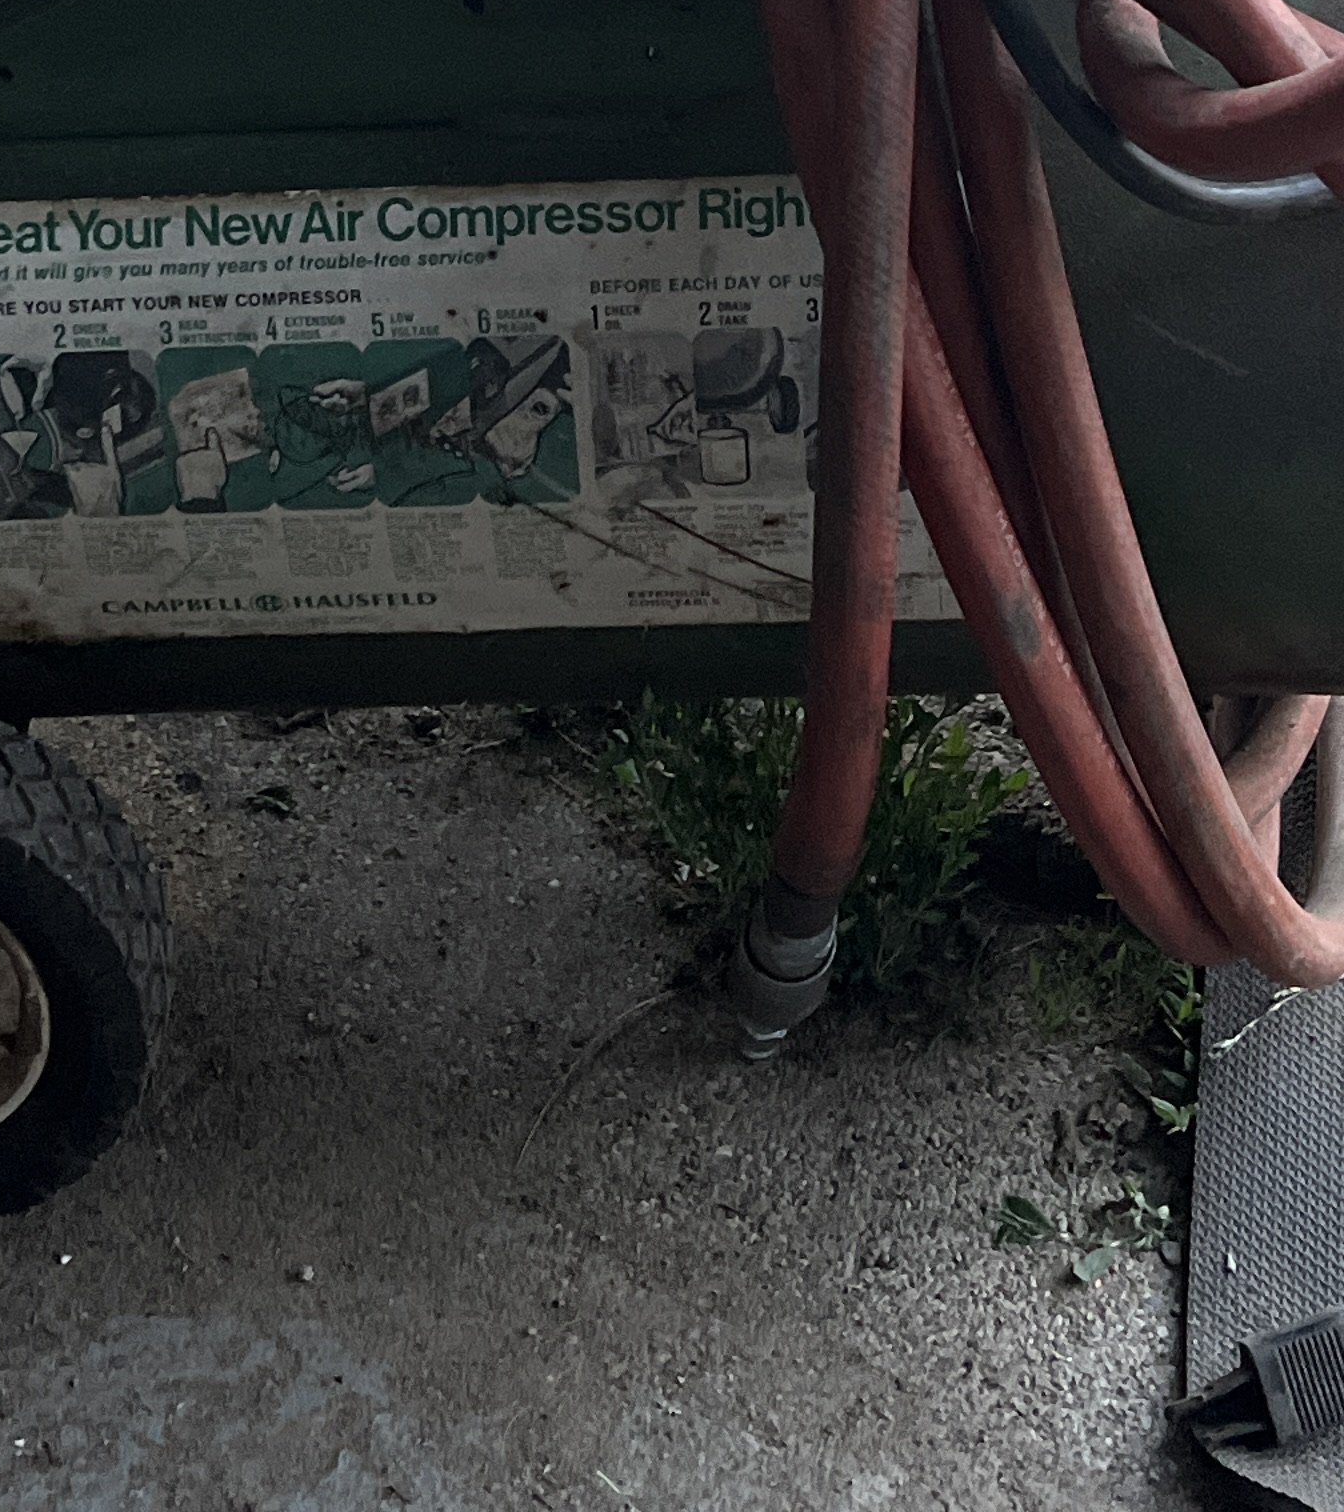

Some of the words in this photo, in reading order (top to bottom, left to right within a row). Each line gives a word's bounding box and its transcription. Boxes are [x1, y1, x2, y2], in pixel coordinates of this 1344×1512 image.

[67, 208, 171, 252] Your
[186, 203, 293, 247] New
[299, 199, 364, 244] Air
[377, 196, 685, 245] Compressor
[699, 186, 812, 238] Righ
[15, 266, 28, 282] it
[33, 263, 67, 281] will
[73, 263, 112, 284] give
[119, 265, 153, 284] you
[160, 262, 212, 280] many
[216, 259, 268, 280] years
[274, 255, 295, 273] of
[299, 251, 412, 272] trouble-free
[590, 278, 662, 294] BEFORE
[669, 276, 718, 292] EACH
[725, 275, 761, 291] DAY
[768, 274, 792, 289] OF
[799, 273, 825, 288] US
[23, 300, 62, 315] YOU
[69, 298, 126, 313] START
[131, 295, 182, 311] YOUR
[188, 294, 229, 309] NEW
[235, 289, 362, 307] COMPRESSOR
[699, 301, 712, 327] 2
[806, 297, 820, 322] 3
[265, 316, 278, 341] 4
[371, 312, 385, 337] 5
[477, 308, 492, 334] 6
[590, 304, 599, 330] 1
[53, 323, 68, 349] 2
[159, 320, 173, 345] 3
[101, 596, 247, 615] CAMPBELL
[293, 591, 439, 610] HAUSFELD
